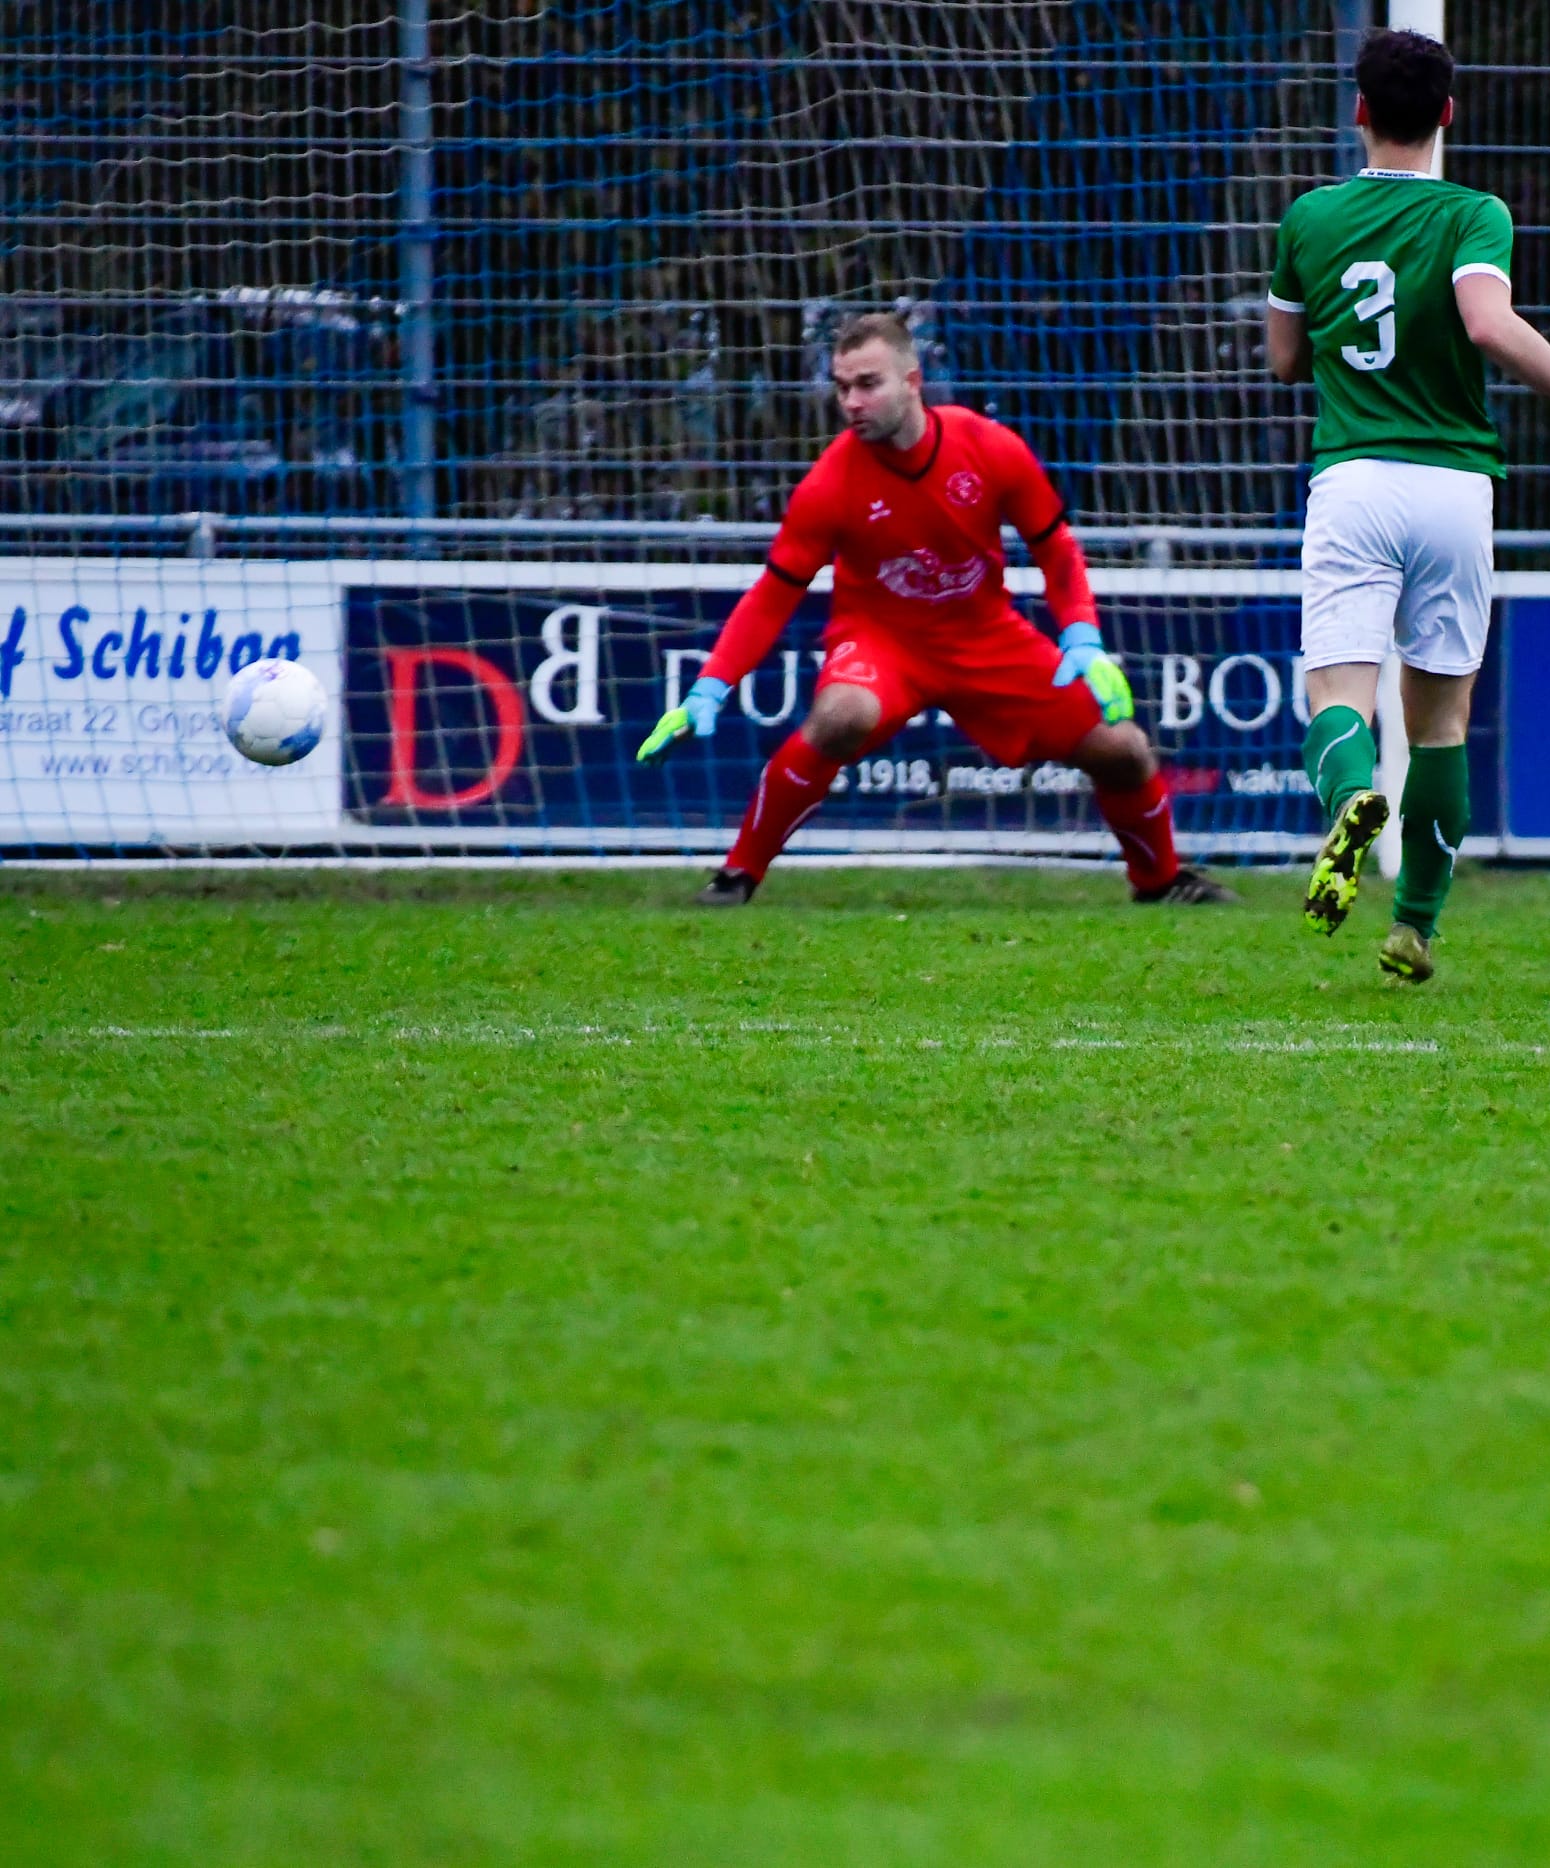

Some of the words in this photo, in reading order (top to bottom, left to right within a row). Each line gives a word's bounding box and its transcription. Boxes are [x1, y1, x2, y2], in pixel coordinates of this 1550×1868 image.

[1340, 260, 1396, 371] 3
[82, 704, 117, 733] 22
[382, 645, 524, 810] D
[857, 759, 940, 796] 1918,
[948, 766, 1024, 794] meer
